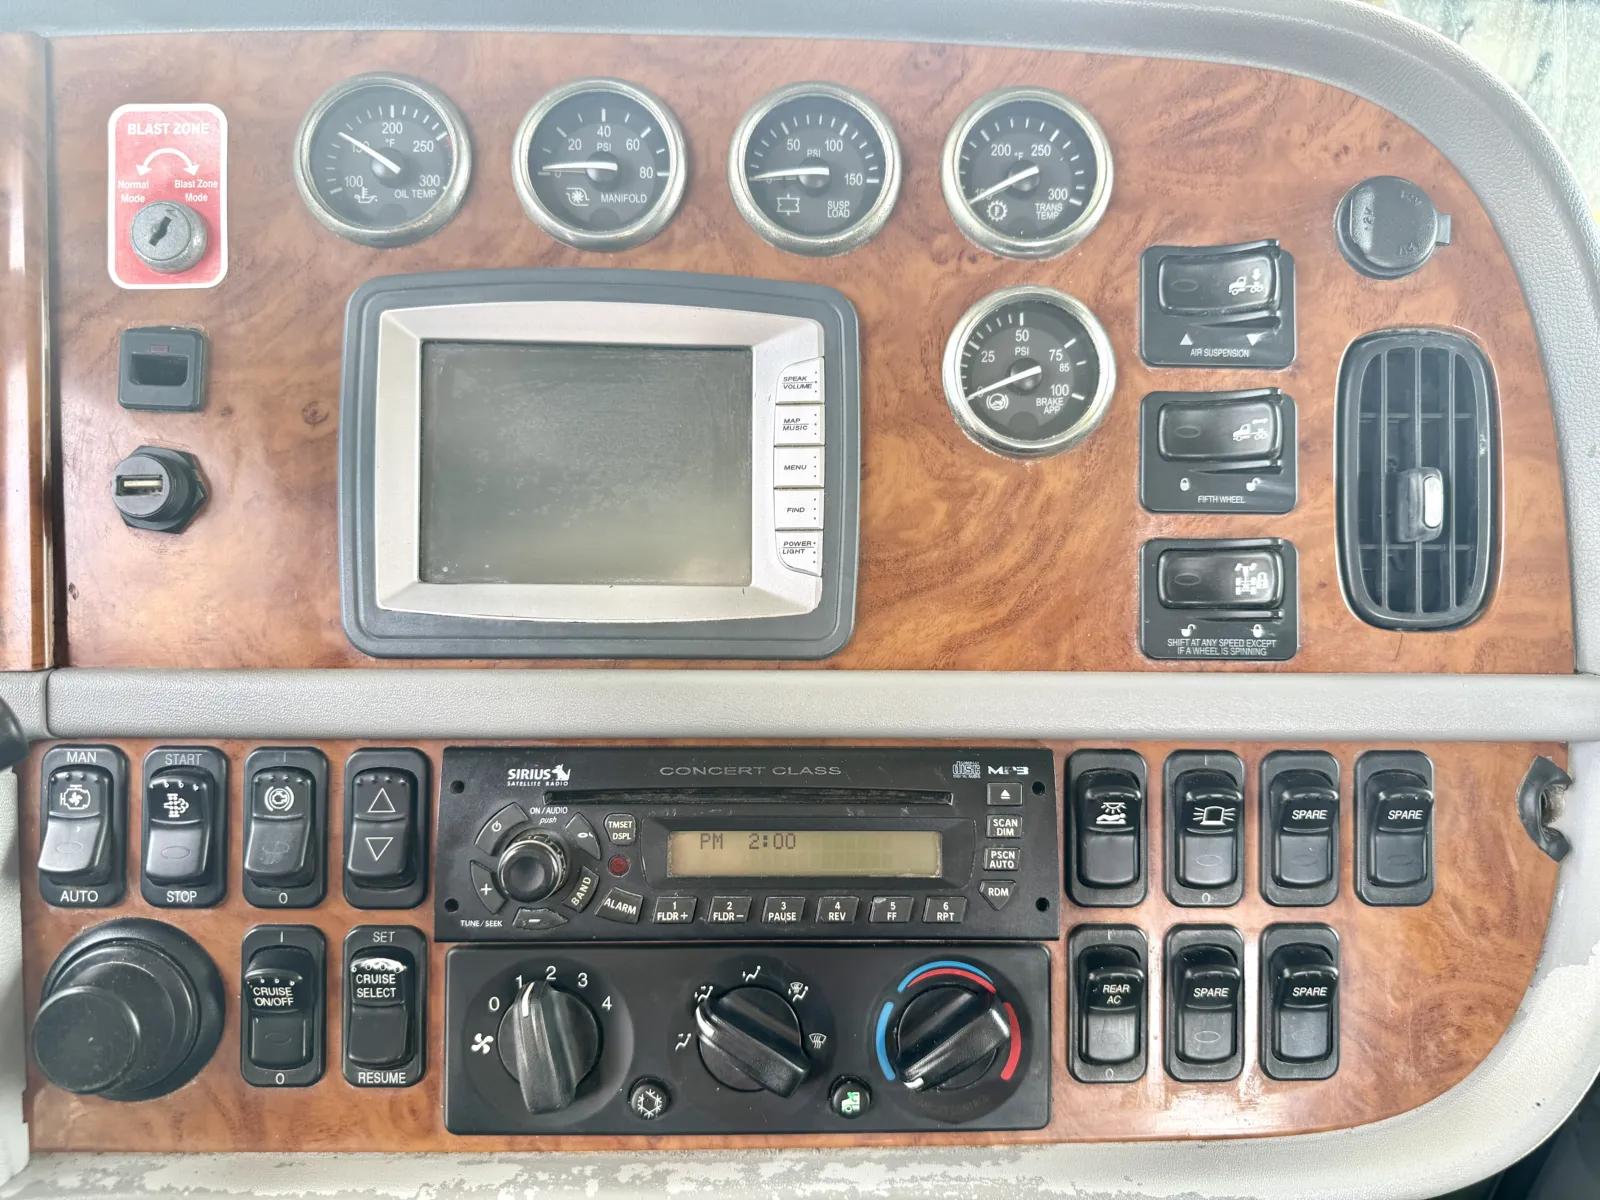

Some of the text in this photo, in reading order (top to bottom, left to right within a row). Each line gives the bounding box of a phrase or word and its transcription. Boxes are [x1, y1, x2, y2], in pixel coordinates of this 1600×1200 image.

[127, 123, 210, 136] BLAST ZONE
[381, 121, 403, 135] 200
[596, 125, 612, 138] 40
[412, 140, 434, 153] 250
[567, 138, 582, 151] 20
[596, 143, 612, 152] PSI
[625, 138, 640, 151] 60
[786, 138, 801, 151] 50
[824, 139, 844, 152] 100
[990, 144, 1012, 157] 200
[1031, 144, 1052, 157] 250
[639, 166, 654, 179] 80
[117, 180, 149, 189] Normal
[174, 179, 218, 189] Blast Zone
[344, 175, 364, 188] 100
[419, 174, 441, 187] 300
[844, 173, 863, 186] 150
[120, 195, 146, 203] Mode
[185, 194, 208, 203] Mode
[394, 189, 437, 199] OIL TEMP
[600, 193, 648, 204] MANIFOLD
[1047, 188, 1068, 201] 300
[827, 200, 850, 210] SUSP
[1034, 203, 1063, 212] TRANS
[827, 208, 850, 218] LOAD
[1036, 211, 1060, 220] TEMP
[1015, 329, 1030, 342] 50
[980, 350, 996, 363] 25
[1014, 347, 1030, 356] PSI
[1048, 349, 1064, 361] 75
[1190, 348, 1250, 358] AIR SUSPENSION
[1059, 363, 1070, 372] 85
[1050, 384, 1069, 396] 100
[1035, 397, 1064, 407] BRAKE
[1043, 405, 1061, 414] APP
[1197, 495, 1246, 504] FIFTH WHEEL
[1167, 638, 1276, 648] SHIFT AT ANY SPEED EXCEPT
[1177, 646, 1267, 657] IF A WHEEL IS SPINNING
[66, 752, 97, 763] MAN
[165, 754, 202, 765] START
[507, 768, 551, 780] SIRIUS
[659, 766, 842, 776] CONCERT CLASS
[1291, 809, 1328, 820] SPARE
[1387, 809, 1424, 820] SPARE
[539, 816, 557, 825] push
[608, 821, 632, 829] TMSET
[993, 818, 1018, 828] SCAN
[996, 827, 1015, 837] DIM
[700, 833, 796, 850] PM 2:00
[990, 850, 1015, 860] PSCN
[989, 860, 1015, 869] AUTO
[60, 890, 98, 902] AUTO
[571, 876, 592, 906] BAND
[988, 887, 1009, 897] RDM
[166, 891, 197, 902] STOP
[604, 896, 637, 915] ALARM
[672, 901, 677, 910] 1
[727, 901, 733, 910] 2
[781, 901, 787, 910] 3
[834, 901, 841, 910] 4
[890, 901, 896, 910] 5
[943, 901, 949, 910] 6
[768, 912, 797, 921] PAUSE
[828, 912, 846, 921] REV
[887, 912, 897, 921] FF
[936, 912, 955, 921] RPT
[373, 931, 395, 943] SET
[545, 966, 557, 980] 2
[356, 974, 396, 984] CRUISE
[515, 975, 523, 988] 1
[577, 973, 588, 987] 3
[253, 987, 293, 996] CRUISE
[356, 988, 396, 998] SELECT
[1102, 984, 1130, 993] REAR
[1193, 987, 1229, 997] SPARE
[1292, 986, 1328, 997] SPARE
[255, 998, 294, 1006] ON/OFF
[488, 997, 500, 1011] 0
[601, 996, 612, 1011] 4
[1106, 995, 1122, 1004] AC
[358, 1072, 406, 1084] RESUME
